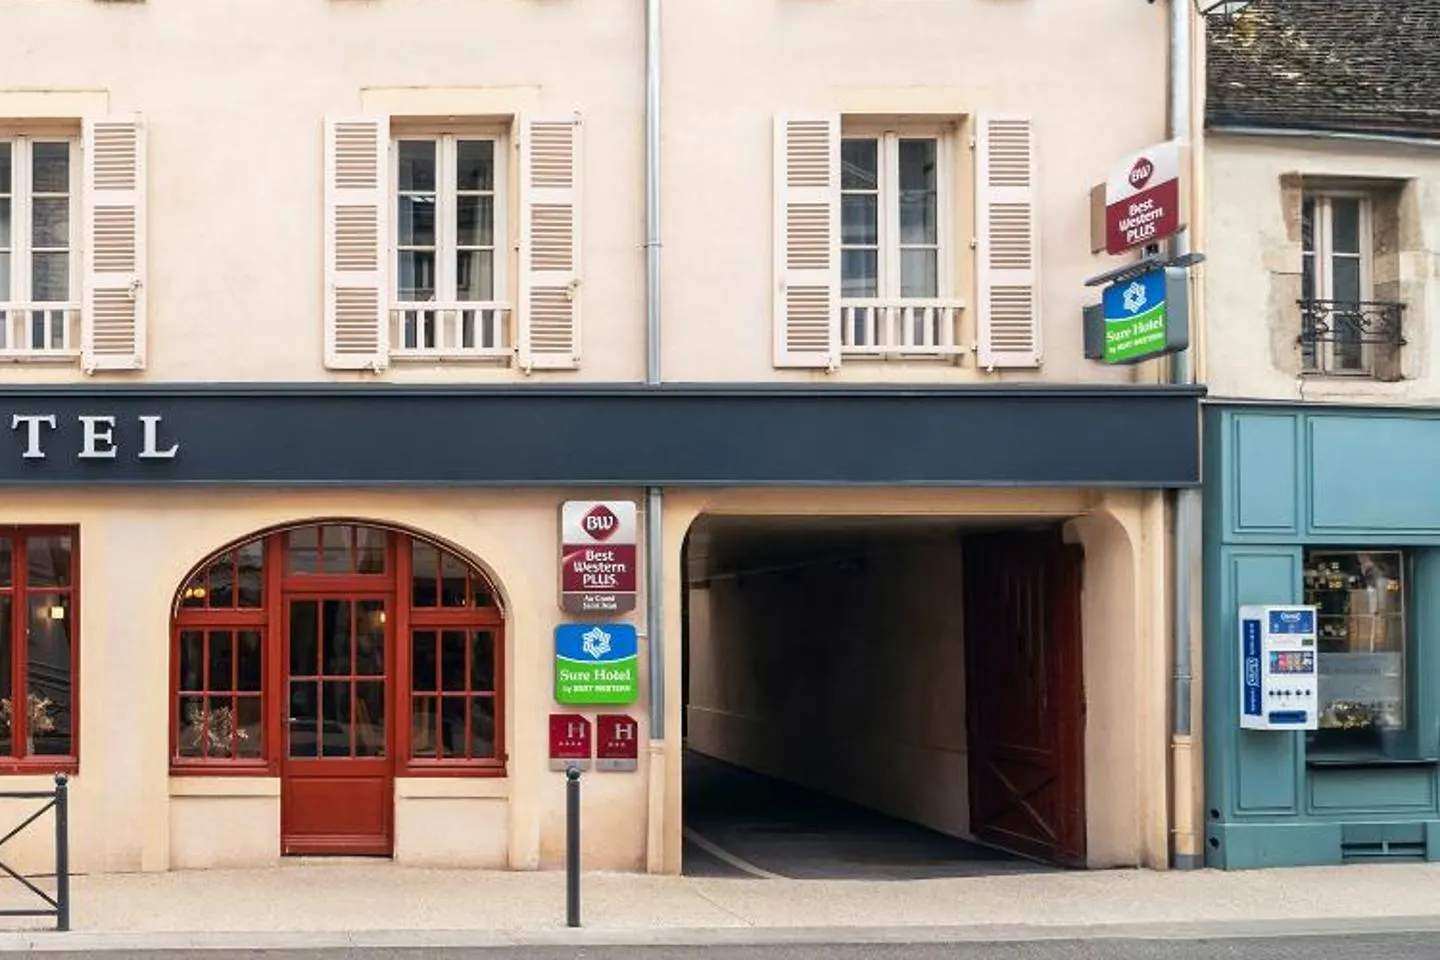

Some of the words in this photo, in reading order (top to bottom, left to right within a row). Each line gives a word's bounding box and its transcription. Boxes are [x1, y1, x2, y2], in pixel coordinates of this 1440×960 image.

[1128, 198, 1153, 216] Best
[1119, 207, 1163, 232] Western
[1126, 222, 1155, 242] PLUS
[586, 516, 614, 530] BW
[585, 550, 615, 561] Best
[573, 561, 626, 573] Western
[583, 573, 617, 585] PLUS
[560, 669, 591, 681] Sure
[594, 668, 631, 681] Hotel
[567, 722, 585, 739] H
[615, 723, 633, 740] H
